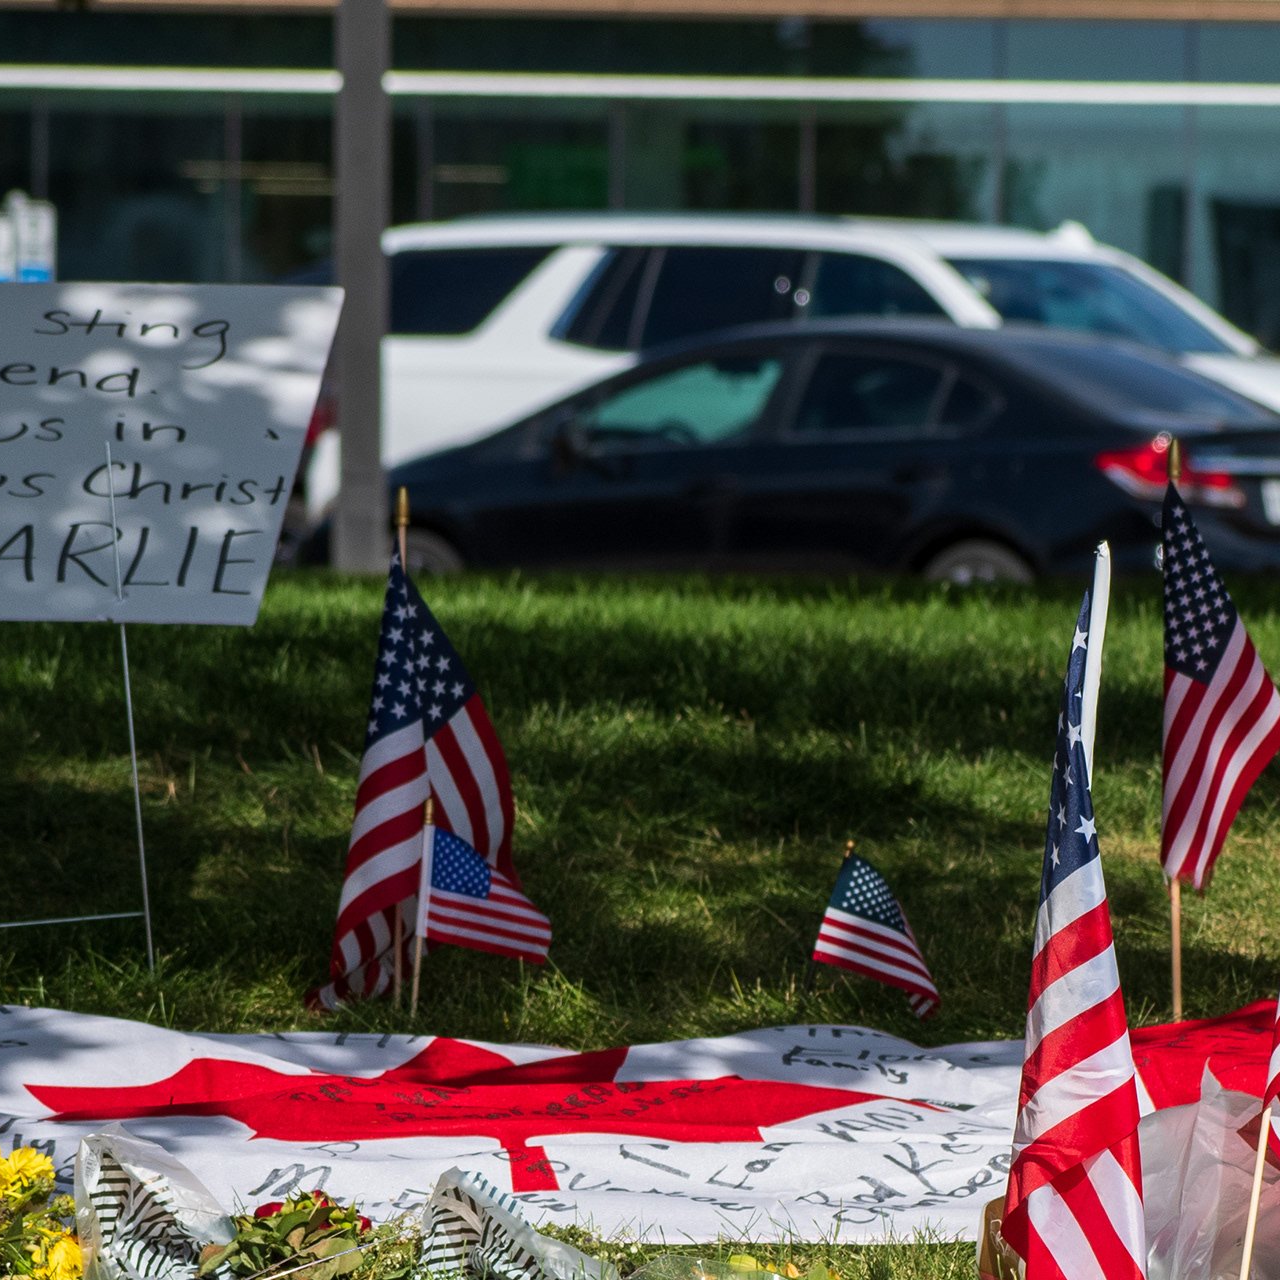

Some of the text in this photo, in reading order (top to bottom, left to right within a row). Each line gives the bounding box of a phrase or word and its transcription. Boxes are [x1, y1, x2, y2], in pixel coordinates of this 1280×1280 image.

[35, 309, 231, 370] sting
[116, 414, 187, 442] in
[83, 460, 287, 505] Christ
